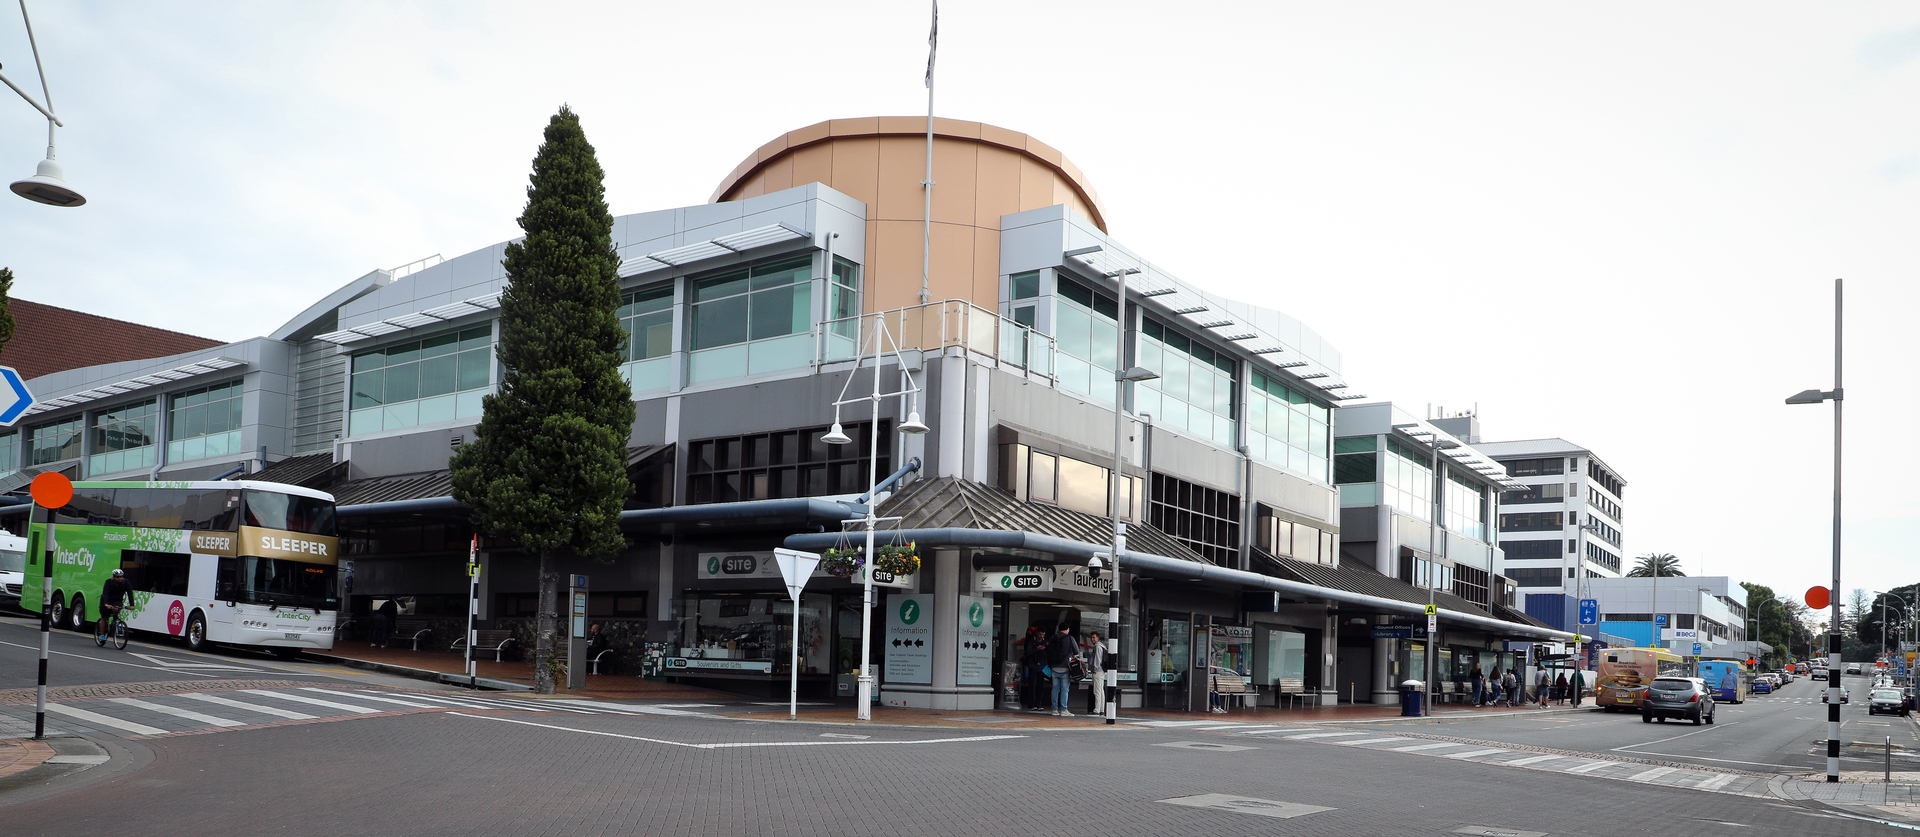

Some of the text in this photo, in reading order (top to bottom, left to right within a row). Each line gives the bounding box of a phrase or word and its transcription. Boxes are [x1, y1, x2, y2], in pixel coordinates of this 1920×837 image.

[103, 532, 129, 542] #nzallover
[196, 535, 230, 551] SLEEPER
[261, 536, 328, 556] SLEEPER
[56, 546, 96, 573] InterCity
[577, 575, 586, 588] D
[1426, 605, 1434, 614] A
[281, 612, 312, 622] InterCity
[891, 626, 928, 635] Information
[962, 628, 989, 638] Information
[696, 660, 719, 668] Souvenirs
